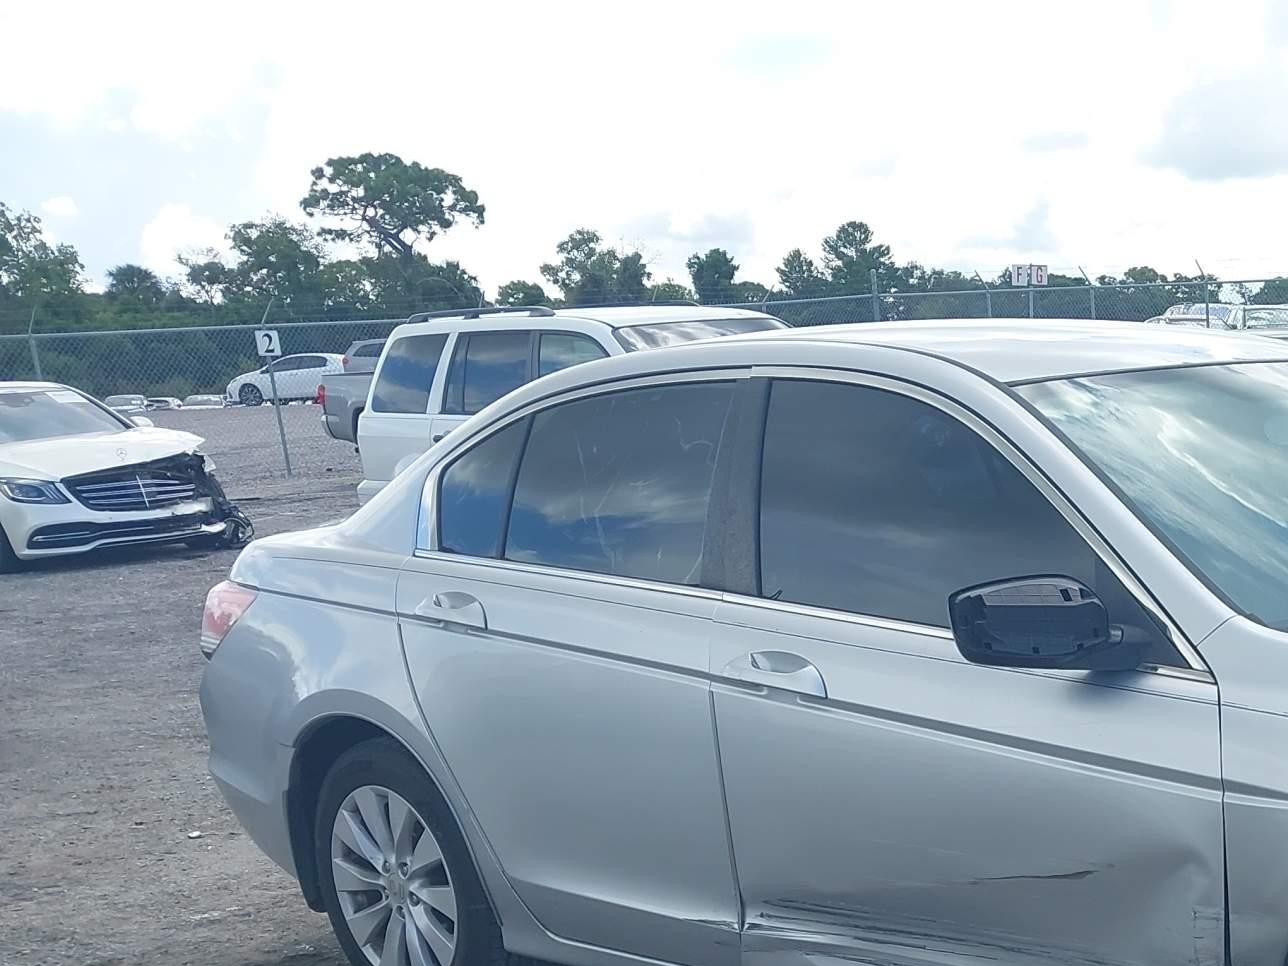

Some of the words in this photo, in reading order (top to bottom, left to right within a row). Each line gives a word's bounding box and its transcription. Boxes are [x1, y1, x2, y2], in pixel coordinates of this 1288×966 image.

[1016, 266, 1023, 283] F
[1036, 266, 1043, 283] G
[262, 333, 275, 353] 2
